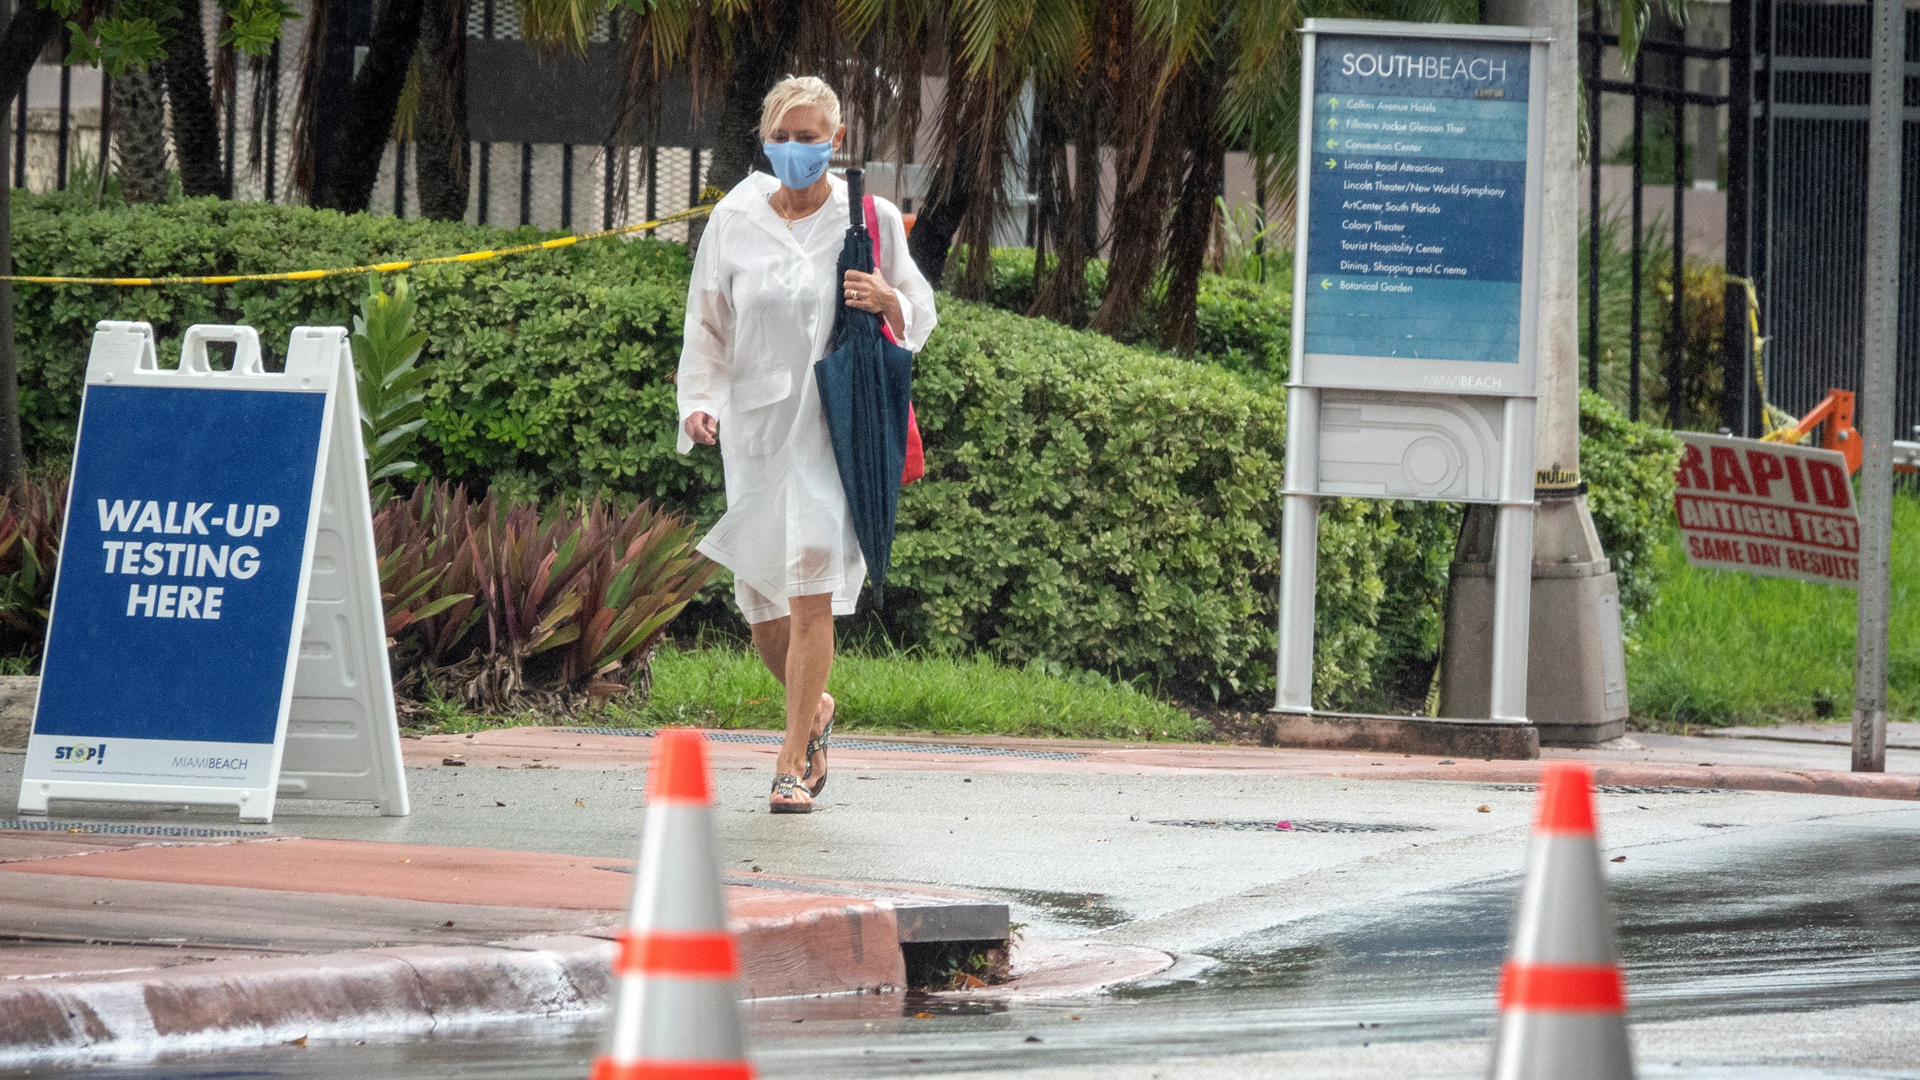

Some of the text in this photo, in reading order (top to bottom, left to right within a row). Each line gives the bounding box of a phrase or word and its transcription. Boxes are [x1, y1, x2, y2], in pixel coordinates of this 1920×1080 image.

[1342, 53, 1507, 82] SOUTHBEACH
[1346, 99, 1437, 113] Collins Avenue Hotels
[1345, 119, 1380, 130] Fillmore
[1409, 122, 1445, 133] Gleason
[1345, 139, 1423, 152] Convention Center
[1344, 160, 1445, 174] Lincoln Road Attractions
[1343, 180, 1506, 198] Lincoln Theater/New World Symphony
[1342, 200, 1441, 214] ArtCenter South Florida
[1341, 219, 1405, 233] Colony Theater
[1341, 240, 1444, 255] Tourist Hospitality Center
[1340, 260, 1371, 273] Dining,
[1373, 262, 1414, 276] Shopping
[1415, 264, 1432, 274] and
[1340, 280, 1413, 293] Botanical Garden
[1422, 374, 1502, 389] MIAMIBEACH
[1674, 443, 1851, 509] RAPID
[97, 498, 281, 537] WALK-UP
[1681, 498, 1860, 549] ANTIGEN TEST
[1688, 535, 1744, 564] SAME
[1746, 541, 1781, 567] DAY
[102, 540, 261, 580] TESTING
[126, 583, 224, 620] HERE
[171, 756, 249, 771] MIAMIBEACH
